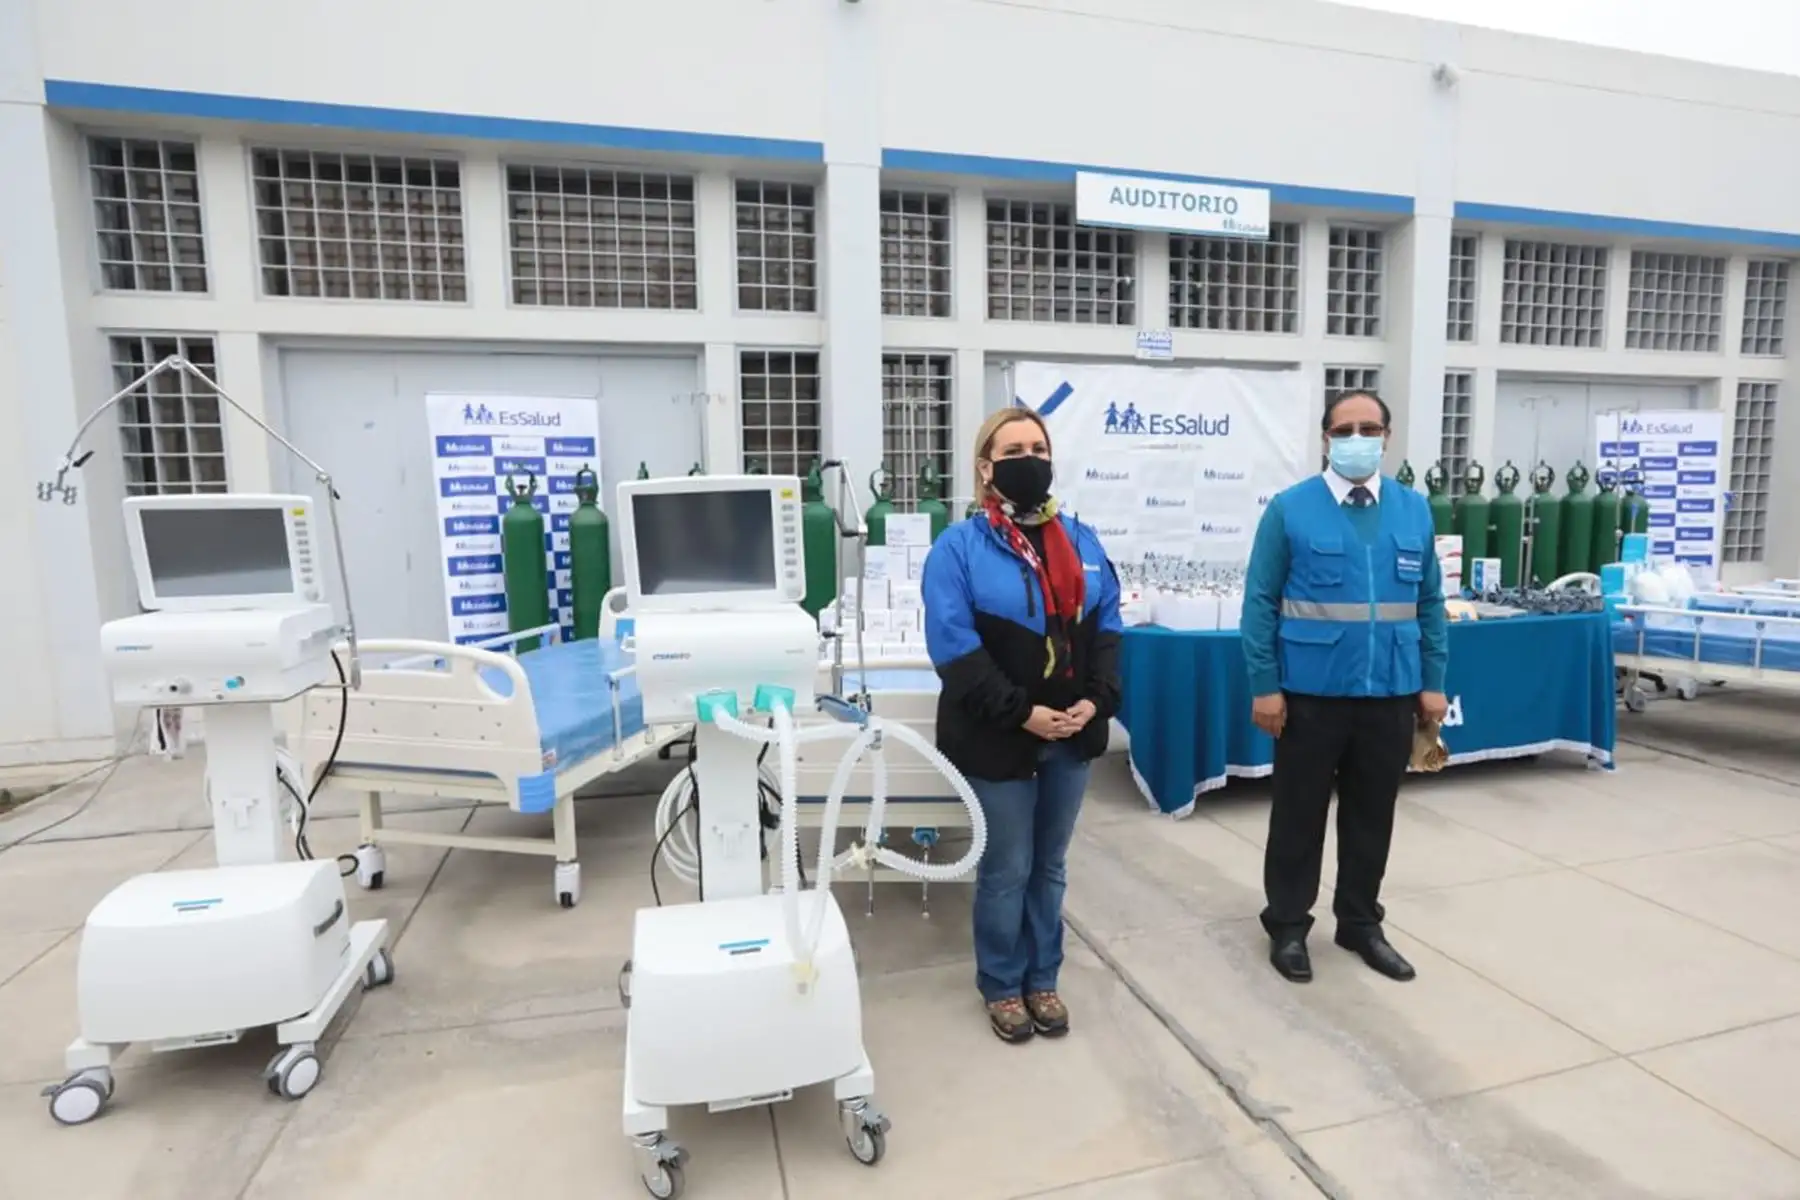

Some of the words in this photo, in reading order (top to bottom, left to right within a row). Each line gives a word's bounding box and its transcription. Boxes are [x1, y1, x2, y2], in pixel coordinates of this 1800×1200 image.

[1109, 186, 1239, 215] AUDITORIO
[499, 411, 562, 427] EsSalud
[1149, 413, 1230, 437] EsSalud
[1646, 423, 1693, 435] EsSalud
